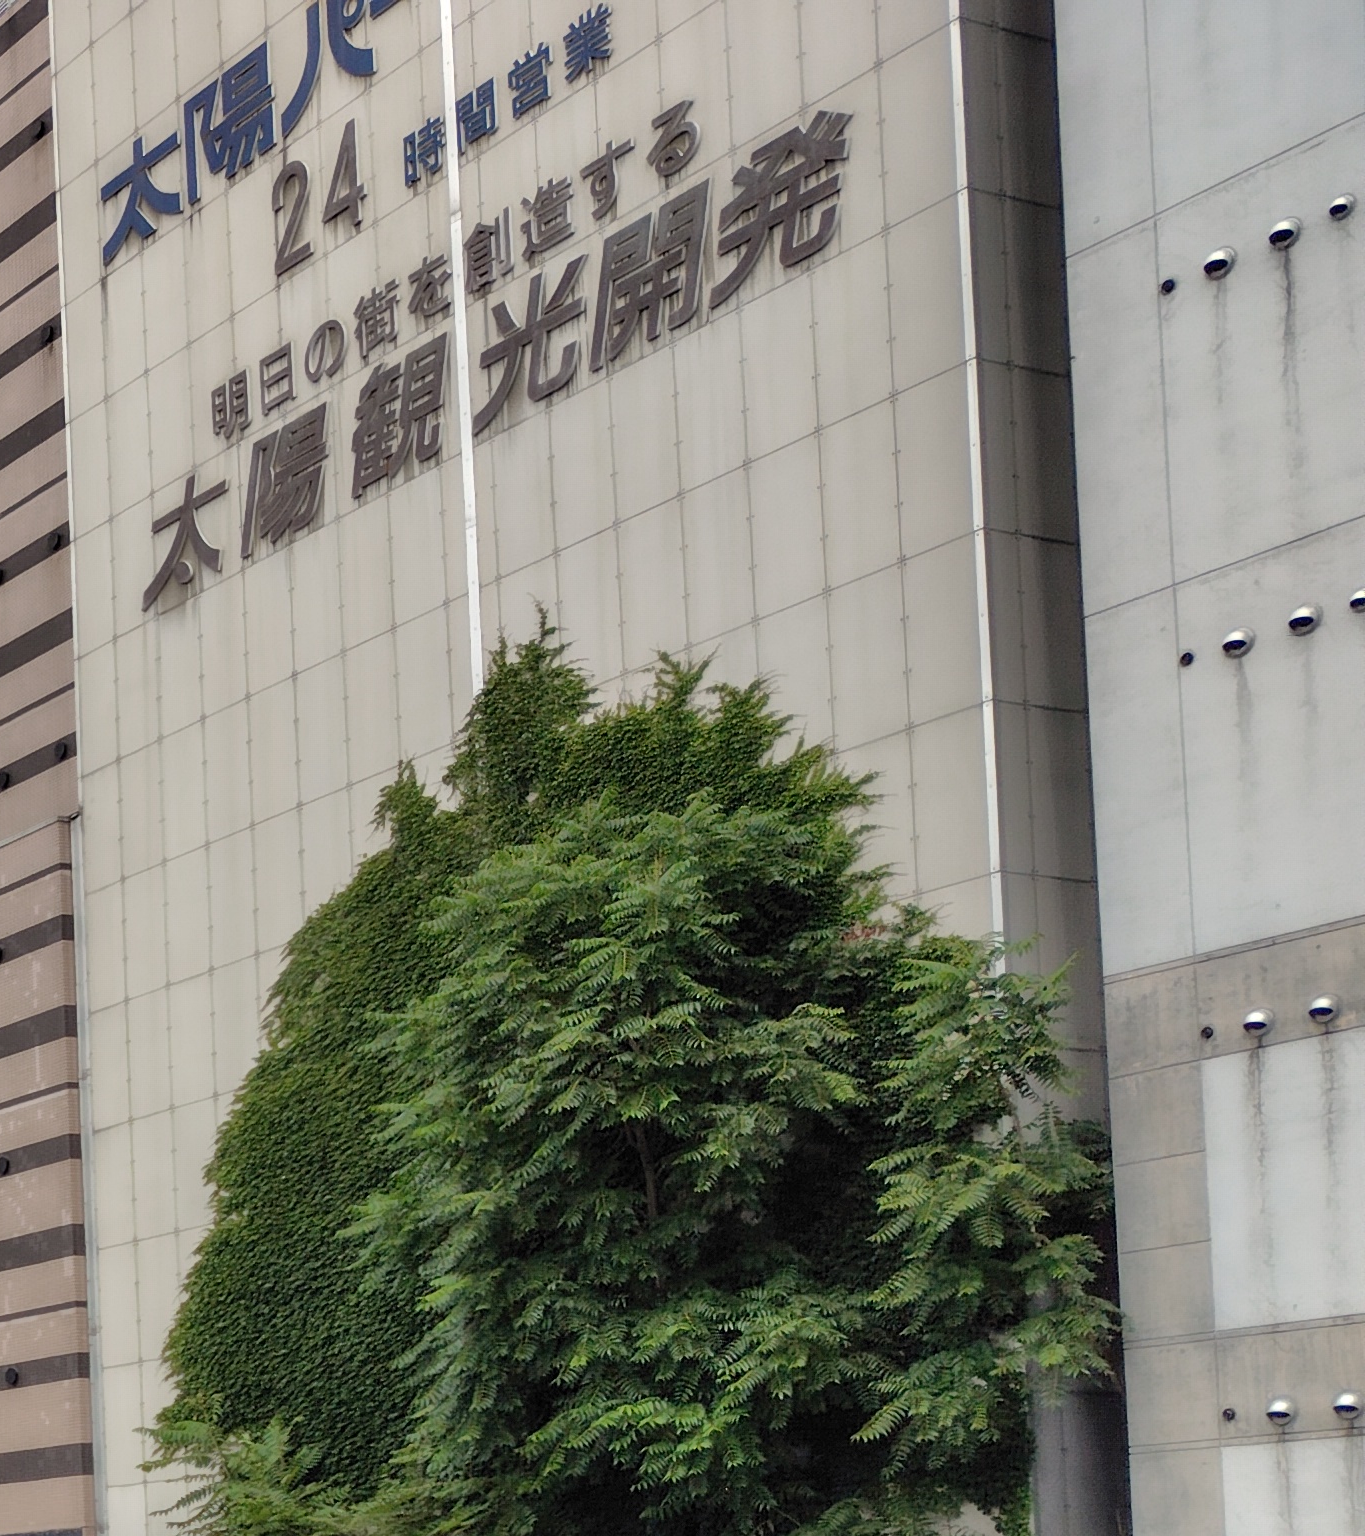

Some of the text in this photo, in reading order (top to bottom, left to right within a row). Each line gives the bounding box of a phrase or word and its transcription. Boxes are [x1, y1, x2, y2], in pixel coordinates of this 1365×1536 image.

[142, 110, 855, 612] 太陽観光開発
[211, 100, 700, 439] 明日の街を創造する
